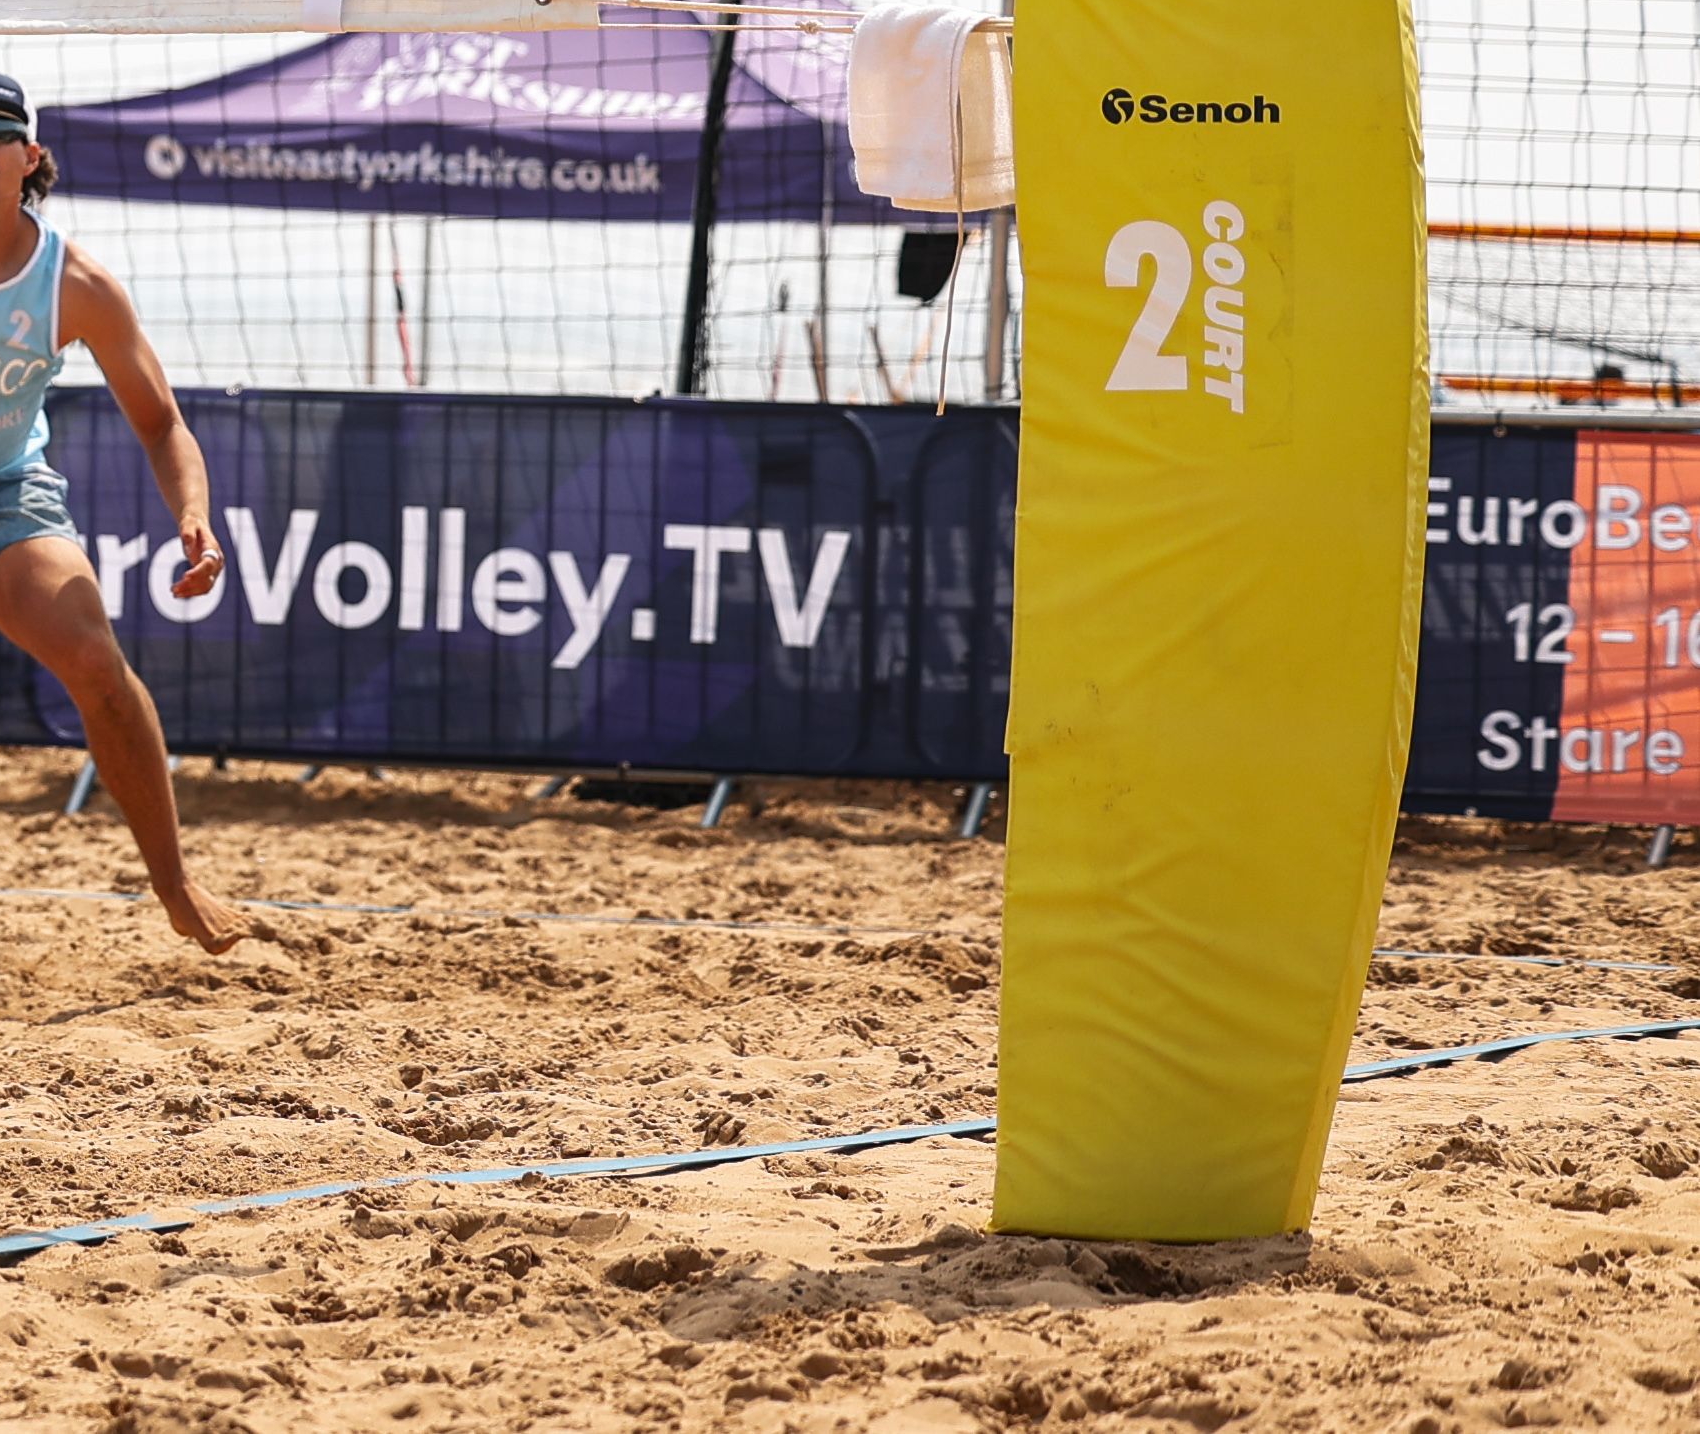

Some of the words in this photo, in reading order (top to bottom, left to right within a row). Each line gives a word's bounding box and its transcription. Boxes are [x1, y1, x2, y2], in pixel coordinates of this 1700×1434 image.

[1139, 95, 1281, 124] Senoh
[191, 137, 661, 194] visiteastyorkshire.co.uk
[6, 309, 32, 350] 2
[1104, 220, 1193, 391] 2
[1203, 199, 1244, 415] COURT
[1426, 476, 1700, 551] EuroBe
[1506, 602, 1578, 664] 12
[1476, 709, 1685, 775] Stare
